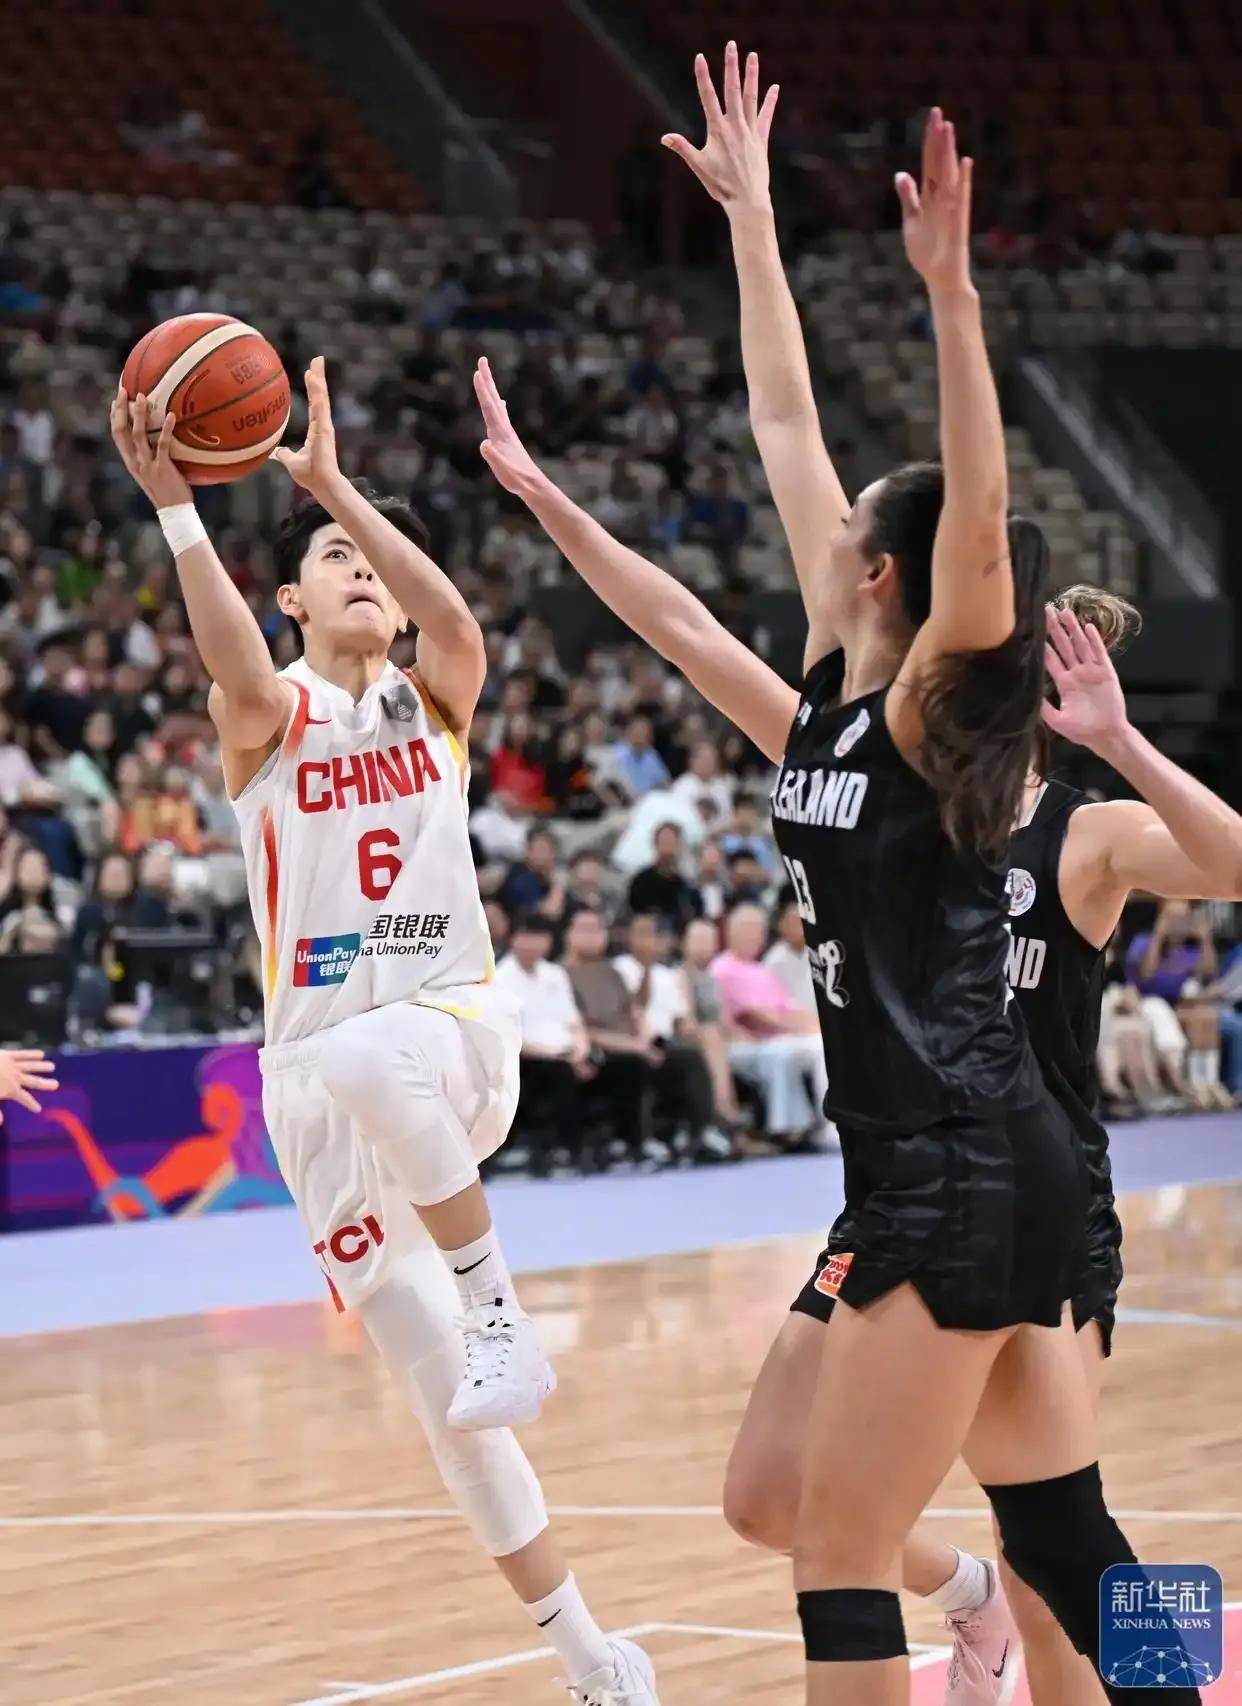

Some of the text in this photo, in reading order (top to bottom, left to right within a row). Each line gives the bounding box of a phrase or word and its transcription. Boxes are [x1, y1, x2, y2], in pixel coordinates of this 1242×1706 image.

[232, 391, 287, 431] molten
[297, 738, 441, 813] CHINA
[358, 827, 402, 901] 6
[297, 947, 357, 964] UnionPay
[376, 941, 442, 958] UnionPay
